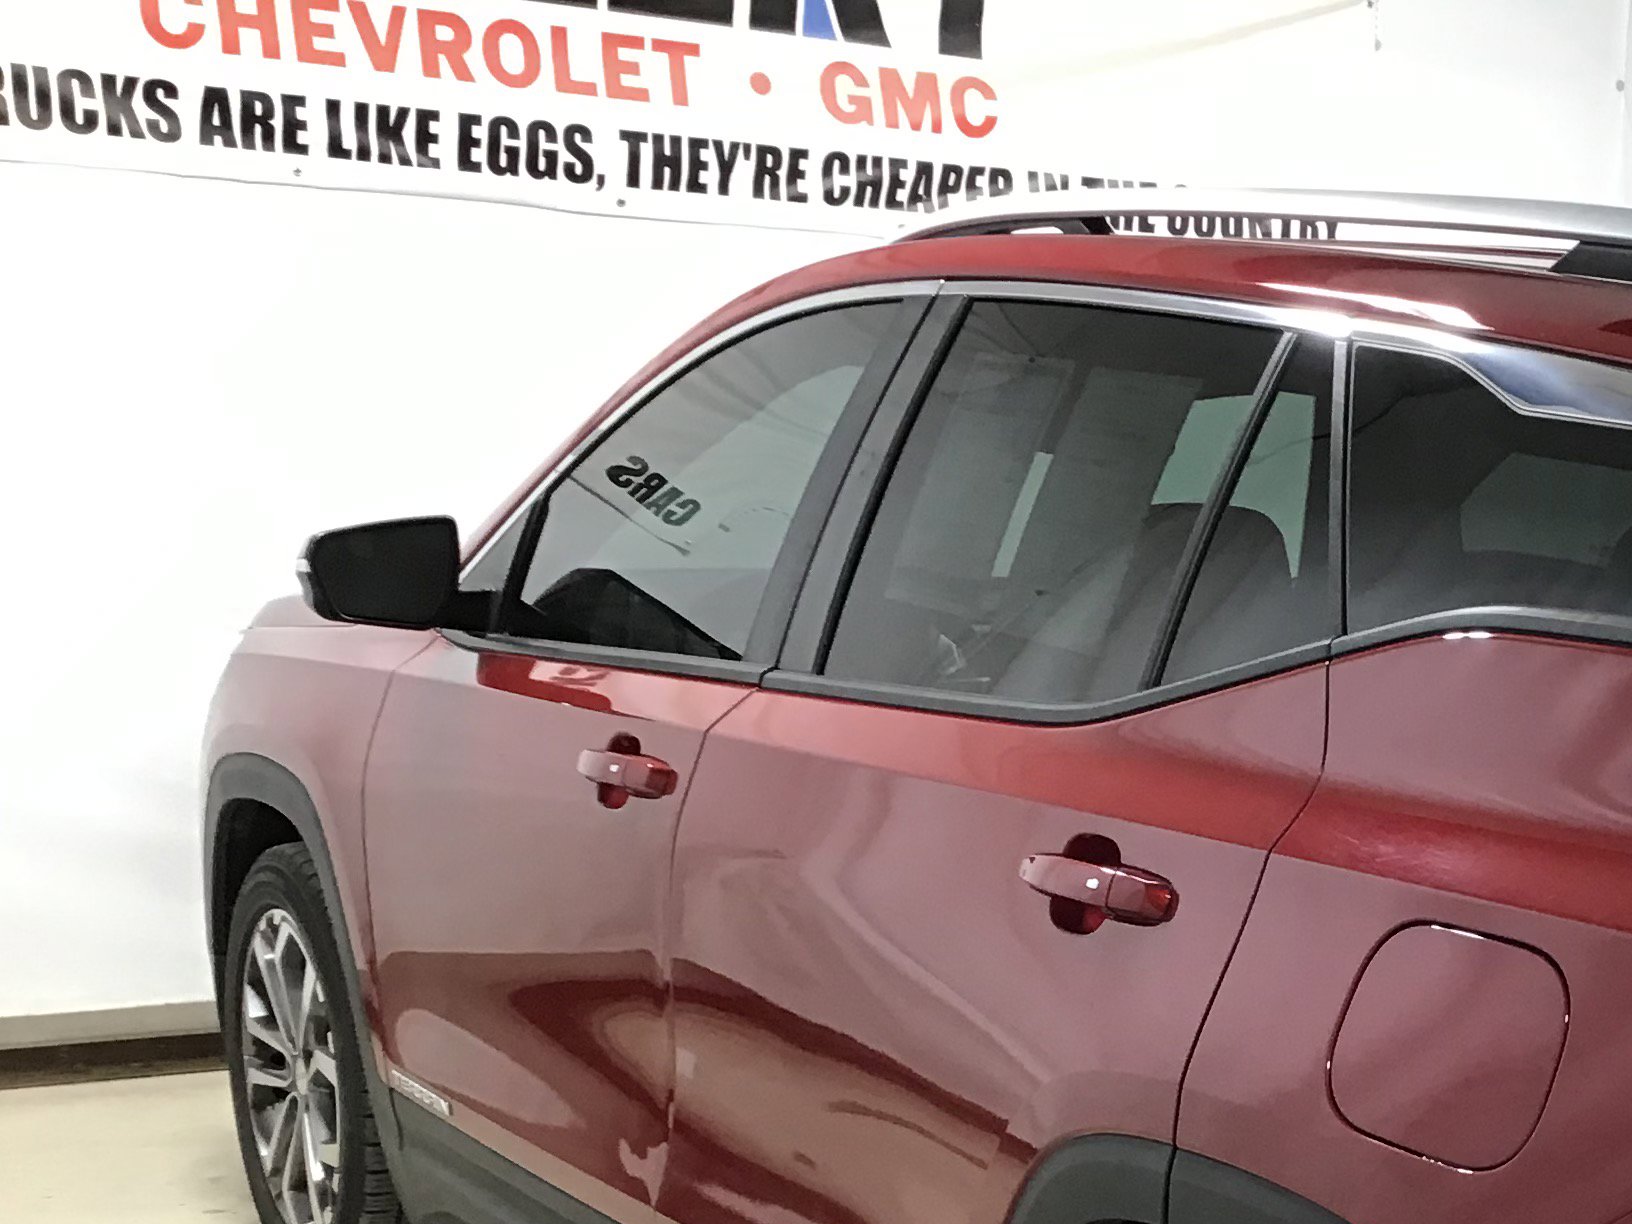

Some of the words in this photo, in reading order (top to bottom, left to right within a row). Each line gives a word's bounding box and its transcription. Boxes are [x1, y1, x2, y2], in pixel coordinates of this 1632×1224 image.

[0, 62, 182, 143] UCKS
[199, 85, 310, 156] ARE
[325, 98, 441, 170] LIKE
[457, 112, 606, 191] EGGS,
[617, 129, 809, 204] THEY'RE
[140, 0, 701, 106] CHEVROLET
[820, 61, 998, 139] GMC
